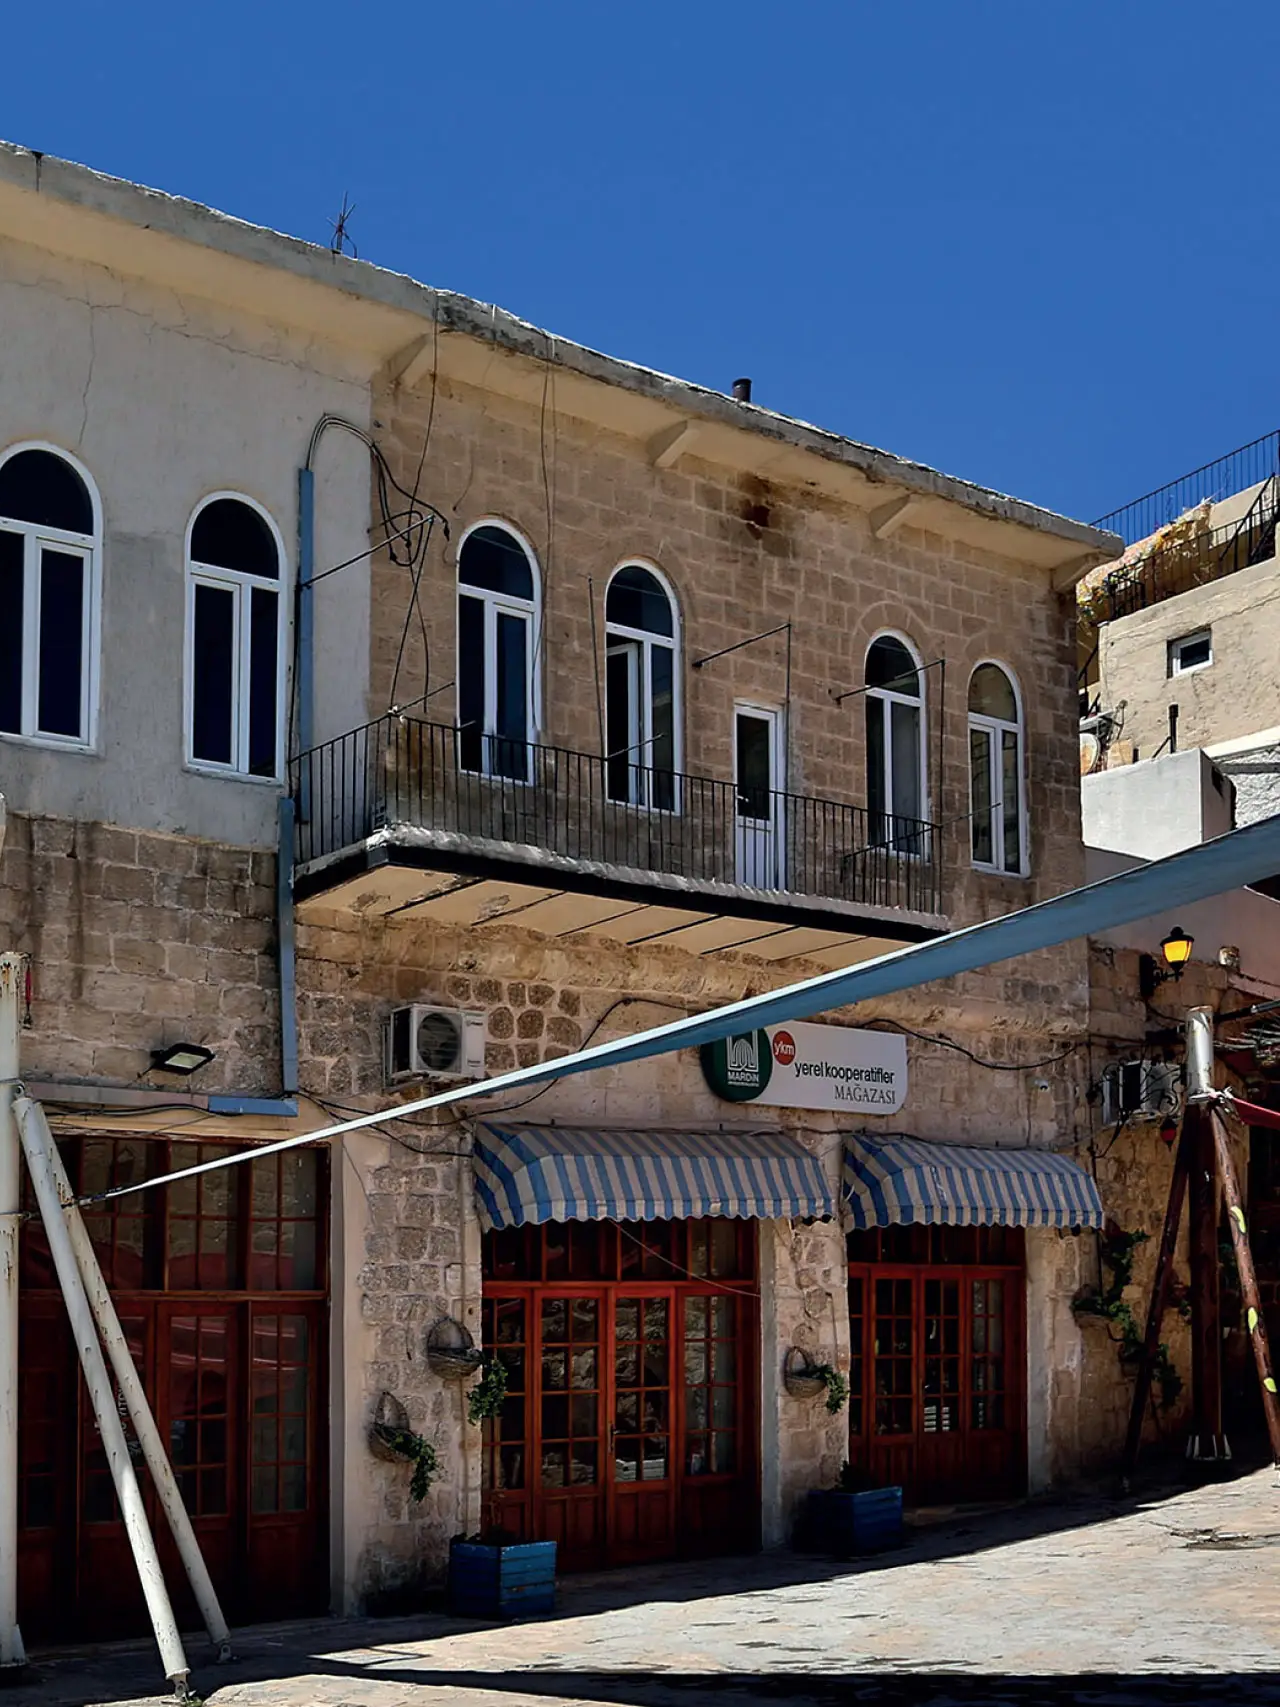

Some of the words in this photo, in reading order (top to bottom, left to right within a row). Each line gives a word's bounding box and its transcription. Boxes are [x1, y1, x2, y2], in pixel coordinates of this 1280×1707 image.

[774, 1041, 795, 1056] ykm
[794, 1061, 823, 1078] yerel
[825, 1062, 895, 1084] kooperatifler
[834, 1082, 896, 1105] MAĞAZASI
